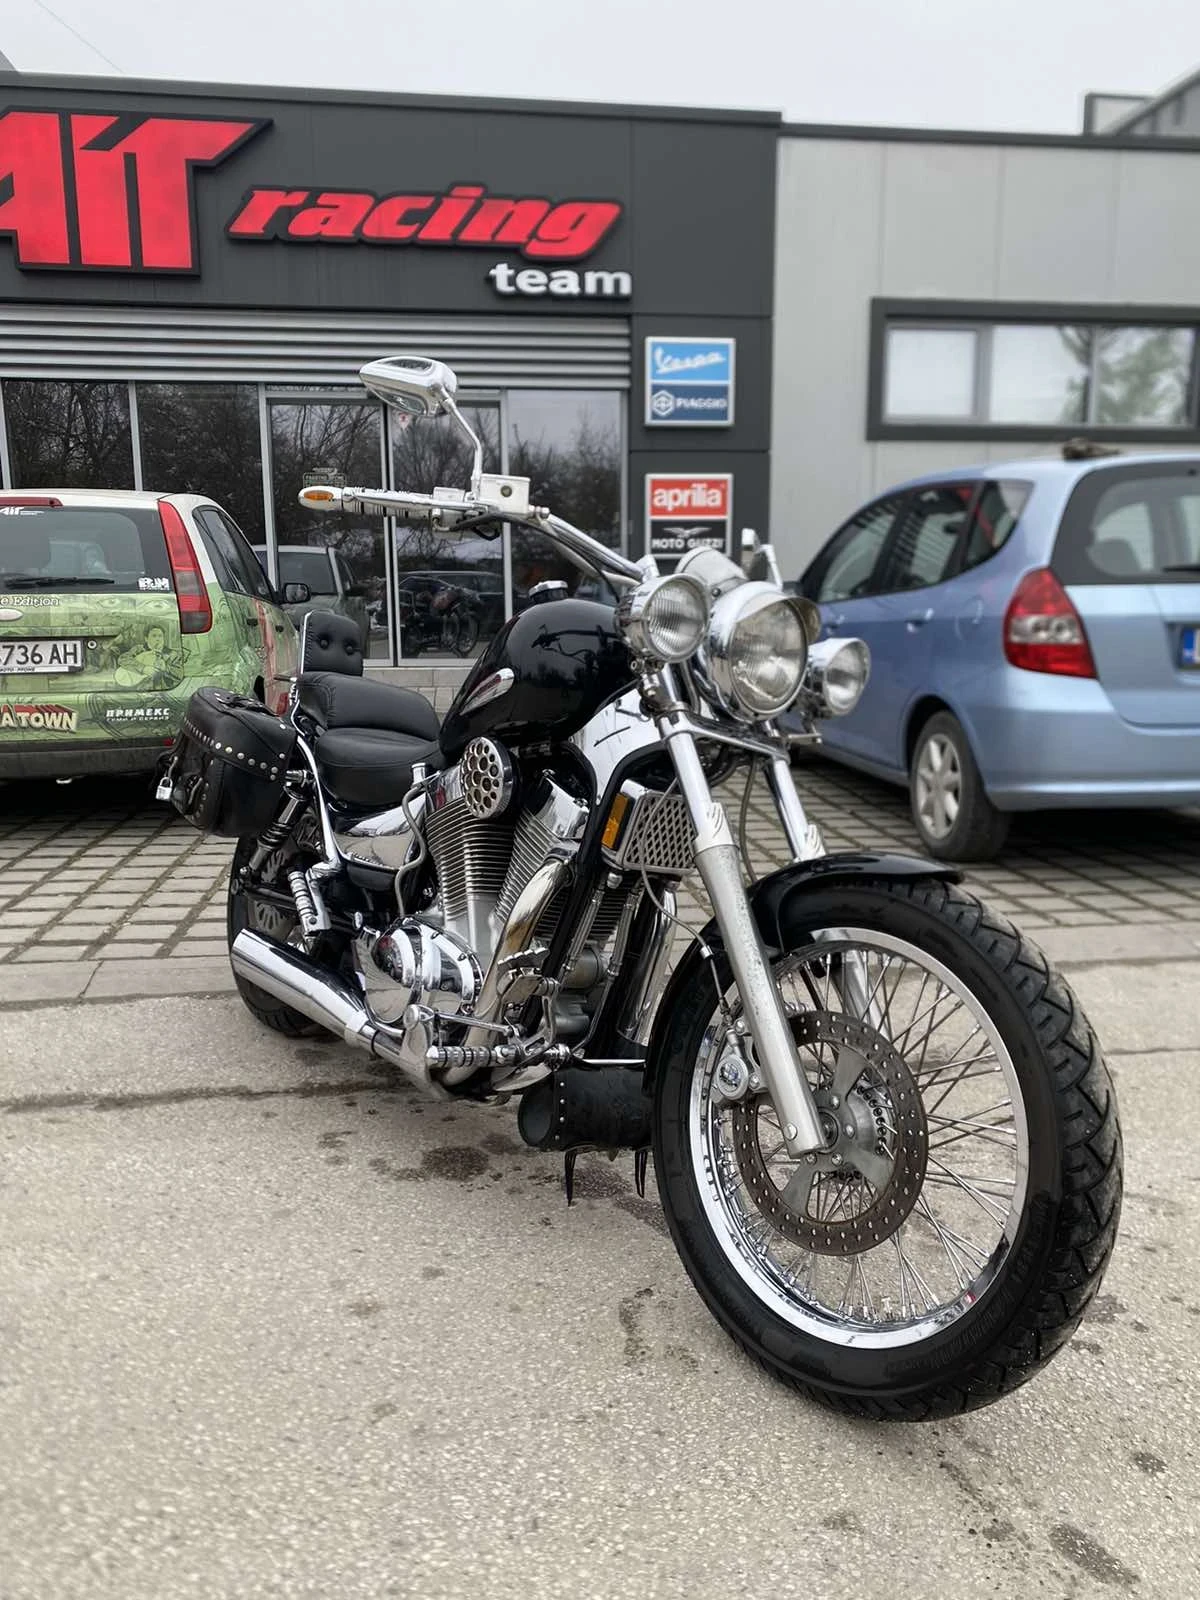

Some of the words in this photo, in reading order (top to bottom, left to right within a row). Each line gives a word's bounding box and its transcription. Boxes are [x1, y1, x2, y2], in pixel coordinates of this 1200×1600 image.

[228, 186, 622, 257] racing
[489, 263, 632, 296] team
[655, 346, 726, 374] Vespa
[676, 398, 727, 409] PIAGGIO
[654, 483, 722, 511] aprilia
[652, 538, 684, 549] MOTO
[14, 596, 60, 607] Edition
[0, 645, 43, 665] 736
[49, 643, 78, 664] AH
[106, 708, 170, 718] ПРИМЕКС
